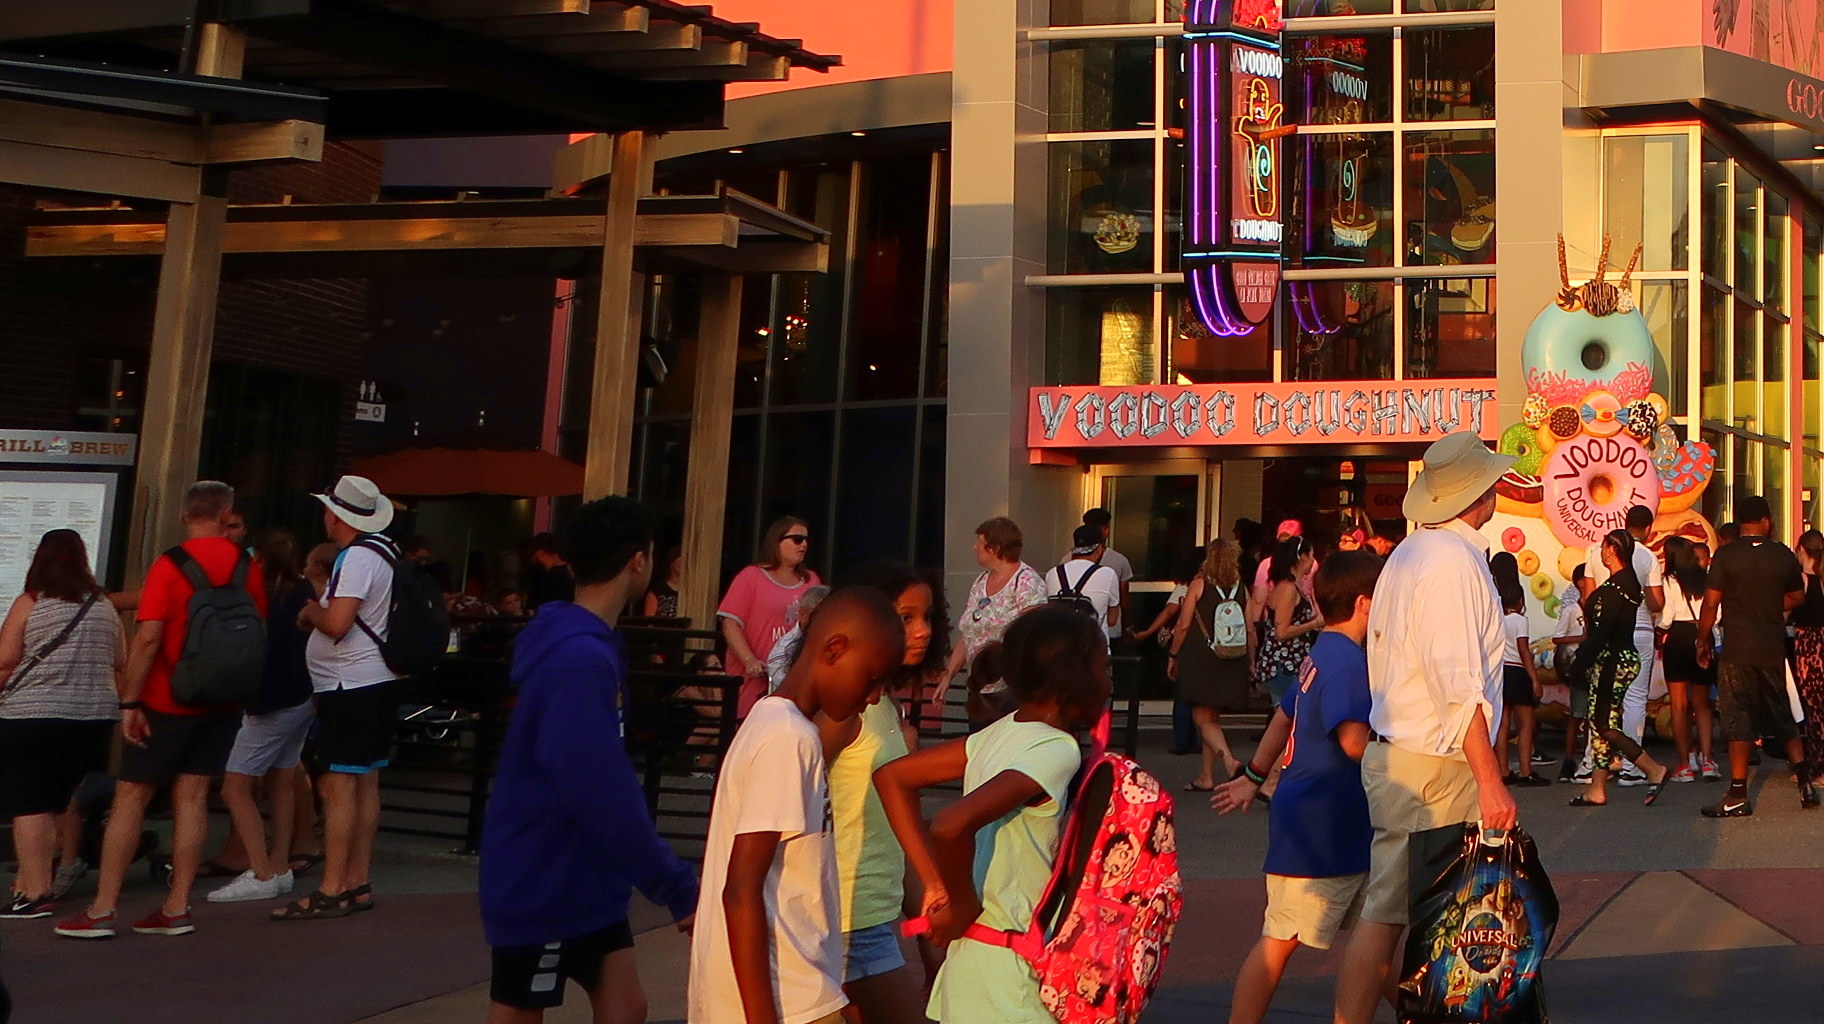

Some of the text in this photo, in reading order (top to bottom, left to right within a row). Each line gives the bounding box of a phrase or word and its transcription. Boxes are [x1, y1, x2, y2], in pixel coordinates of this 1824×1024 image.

[1237, 47, 1283, 79] VOODOO
[1239, 218, 1284, 243] DOUGHNUT
[1037, 388, 1496, 439] VOODOO DOUGHNUT
[68, 440, 129, 455] BREW
[1553, 438, 1648, 481] VOODOO
[1556, 497, 1598, 543] UNIVERSAL
